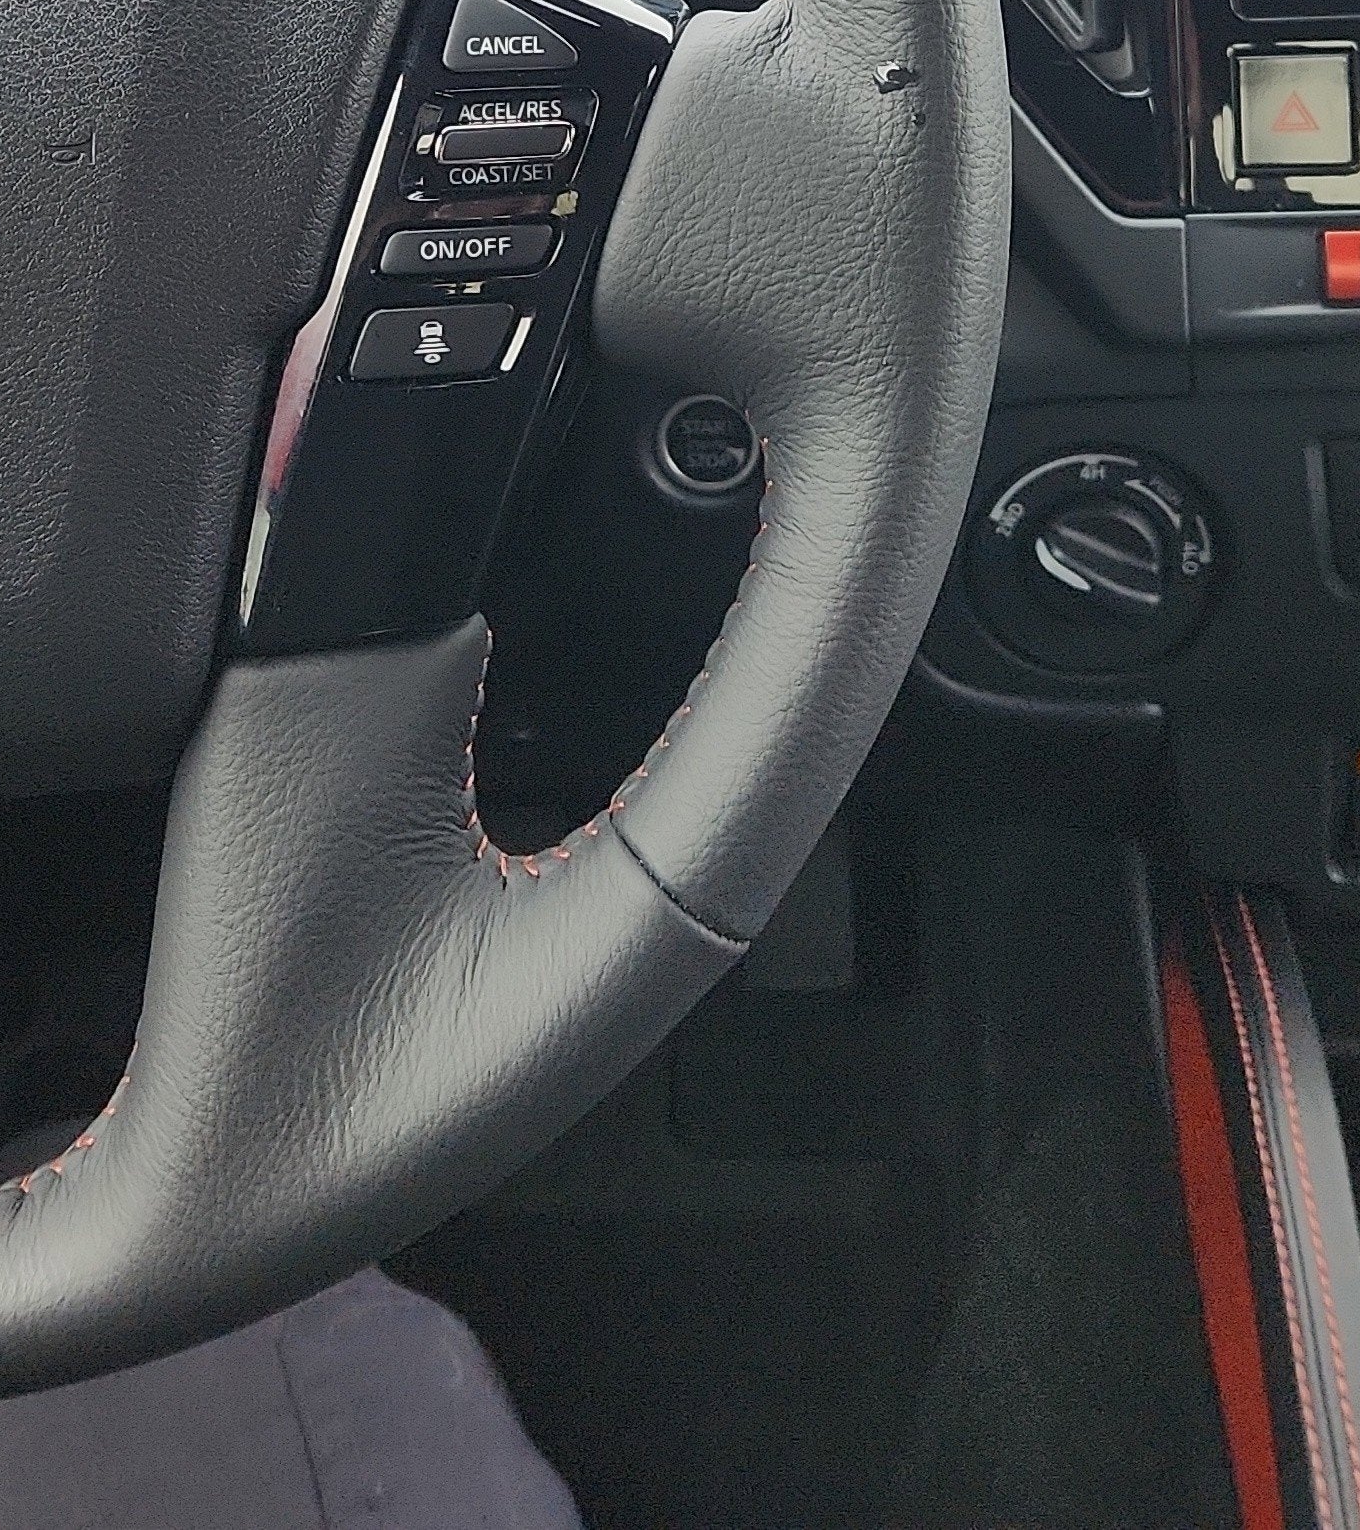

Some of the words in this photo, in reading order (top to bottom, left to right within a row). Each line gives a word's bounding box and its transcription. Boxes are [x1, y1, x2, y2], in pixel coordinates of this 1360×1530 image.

[465, 35, 545, 56] CANCEL
[457, 99, 563, 122] ACCEL/RES
[448, 162, 554, 186] COAST/SET
[419, 236, 512, 260] ON/OFF
